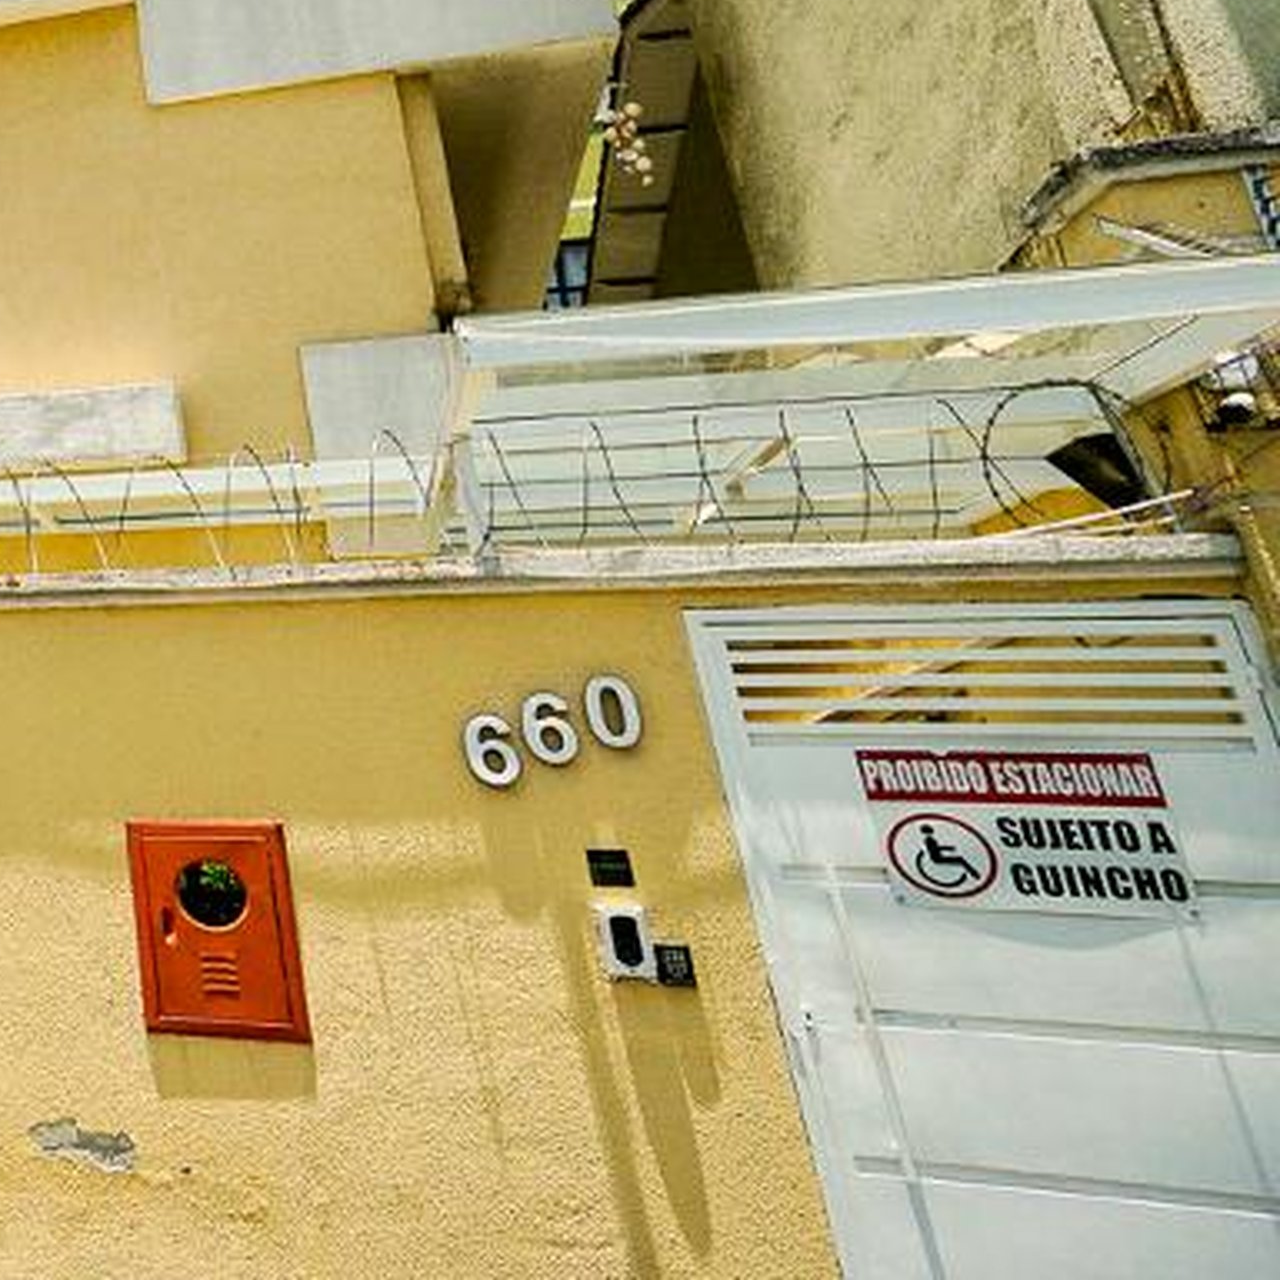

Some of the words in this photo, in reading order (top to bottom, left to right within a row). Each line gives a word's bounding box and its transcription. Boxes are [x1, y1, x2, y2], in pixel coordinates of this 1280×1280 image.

[463, 675, 642, 788] 660
[862, 757, 987, 795] PROIBIDO
[989, 761, 1161, 799] ESTACIONAR
[996, 816, 1141, 854] SUJEITO
[1147, 820, 1177, 855] A
[1010, 863, 1190, 902] GUINCHO
